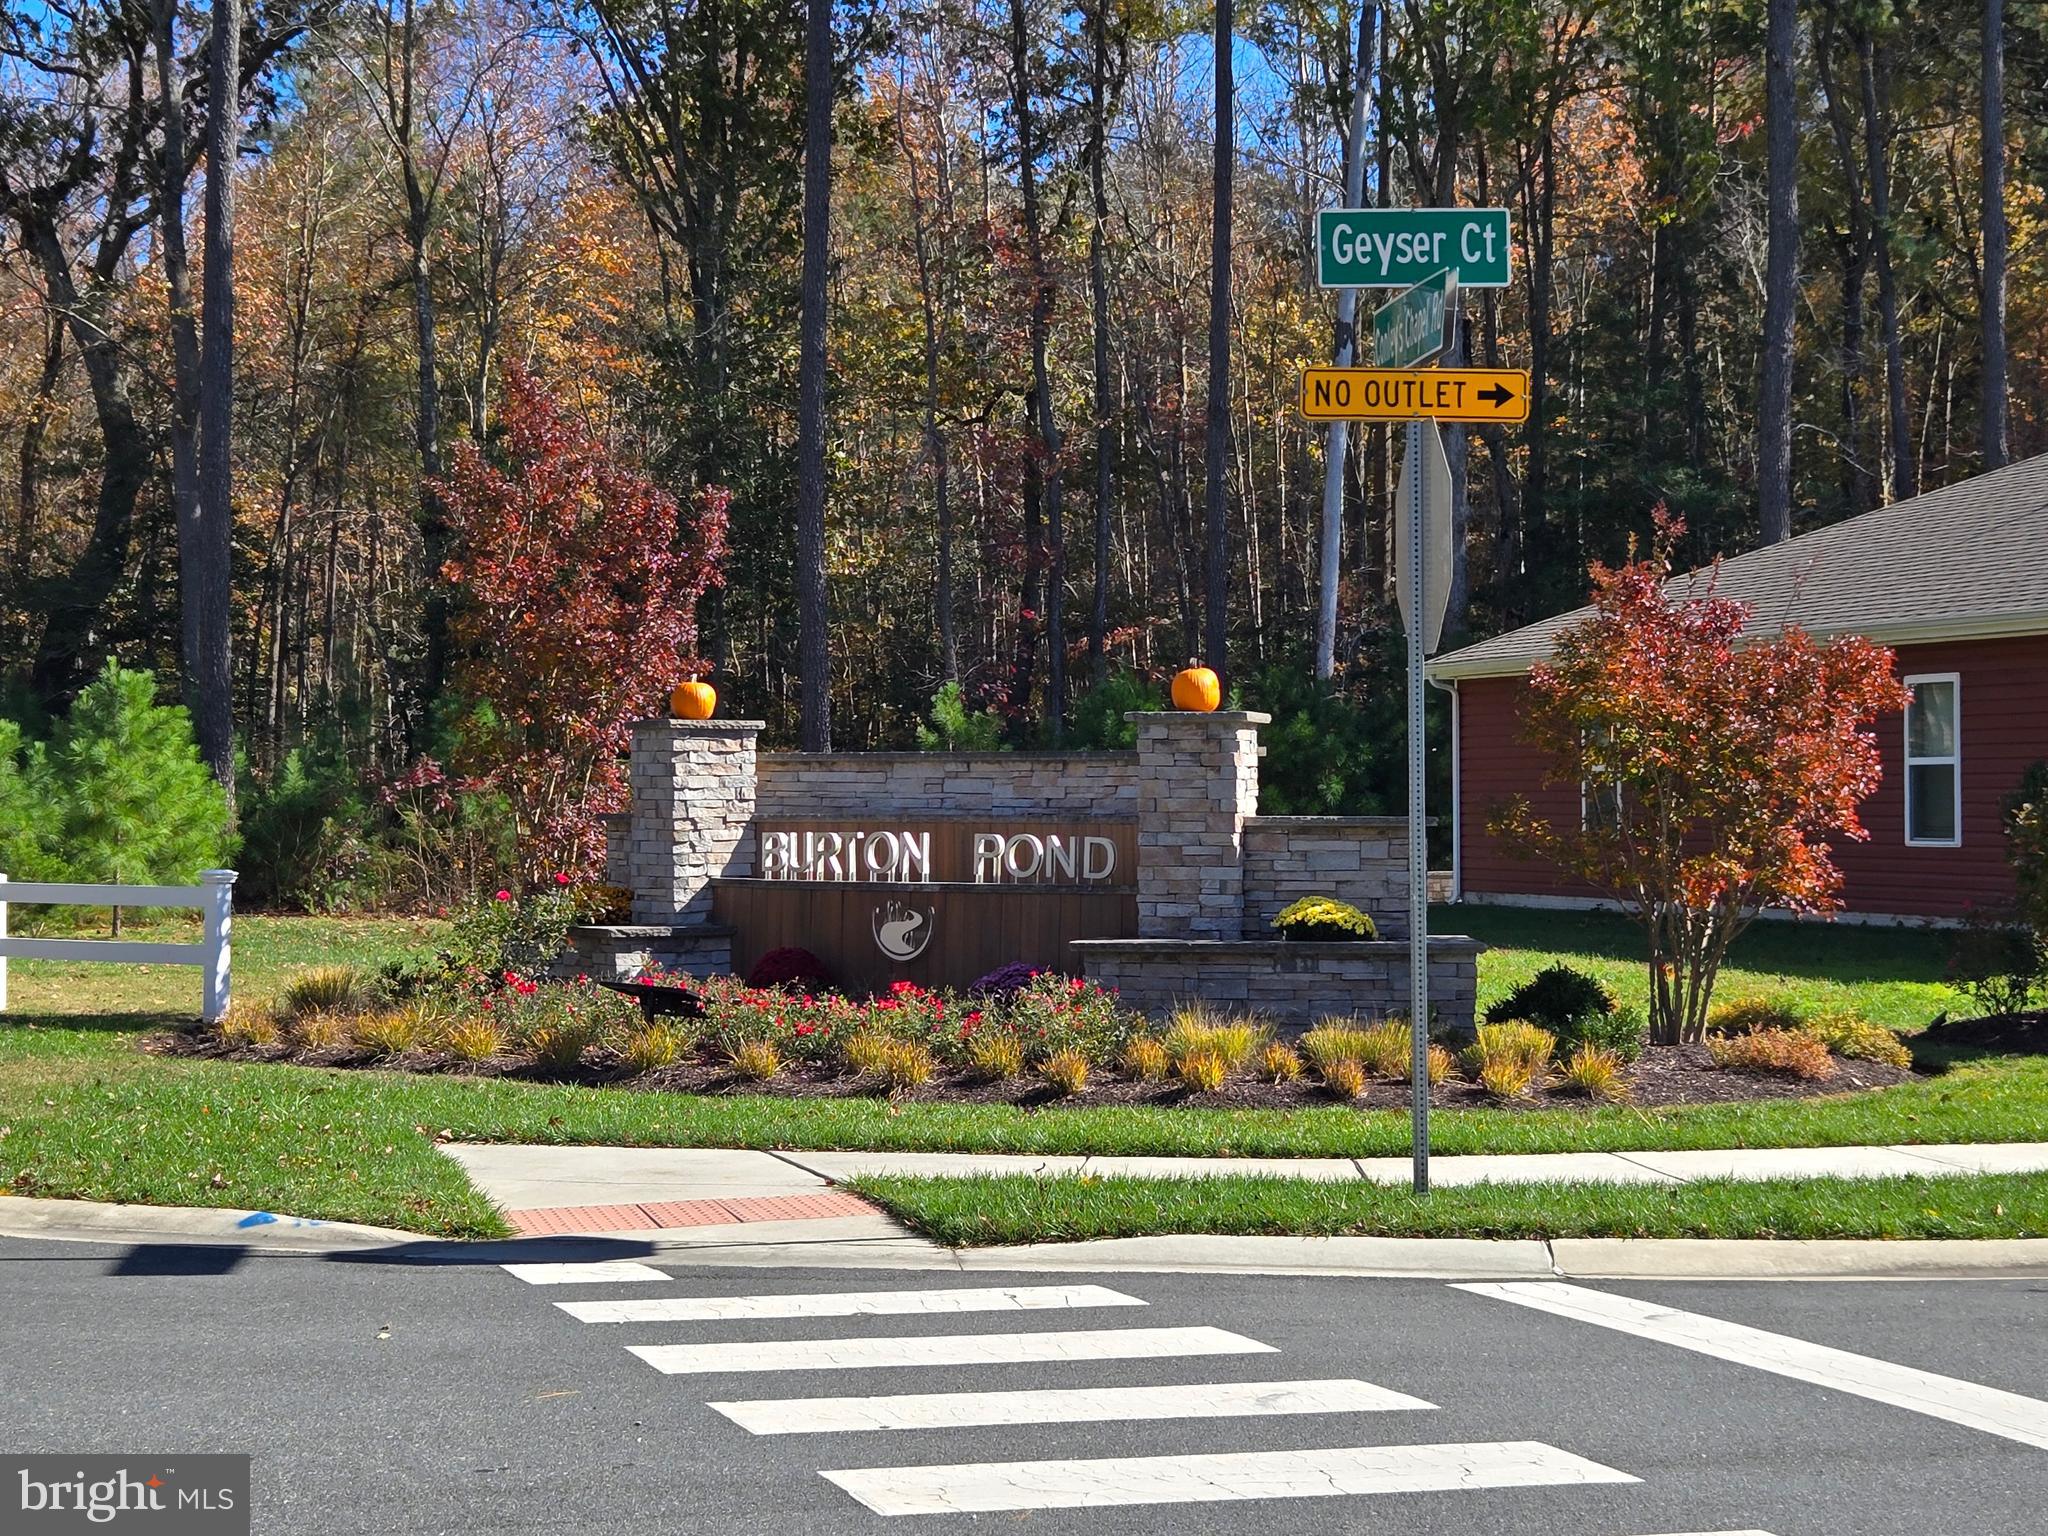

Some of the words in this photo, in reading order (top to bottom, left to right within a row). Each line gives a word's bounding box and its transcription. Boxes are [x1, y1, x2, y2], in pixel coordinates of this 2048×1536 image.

[1332, 223, 1447, 276] Geyser
[1461, 222, 1496, 264] Ct
[1405, 296, 1429, 355] Chapel
[1431, 289, 1444, 333] Rd
[1315, 380, 1351, 407] NO
[1364, 380, 1466, 409] OUTLET
[761, 831, 931, 879] BURTON
[973, 832, 1118, 881] POND
